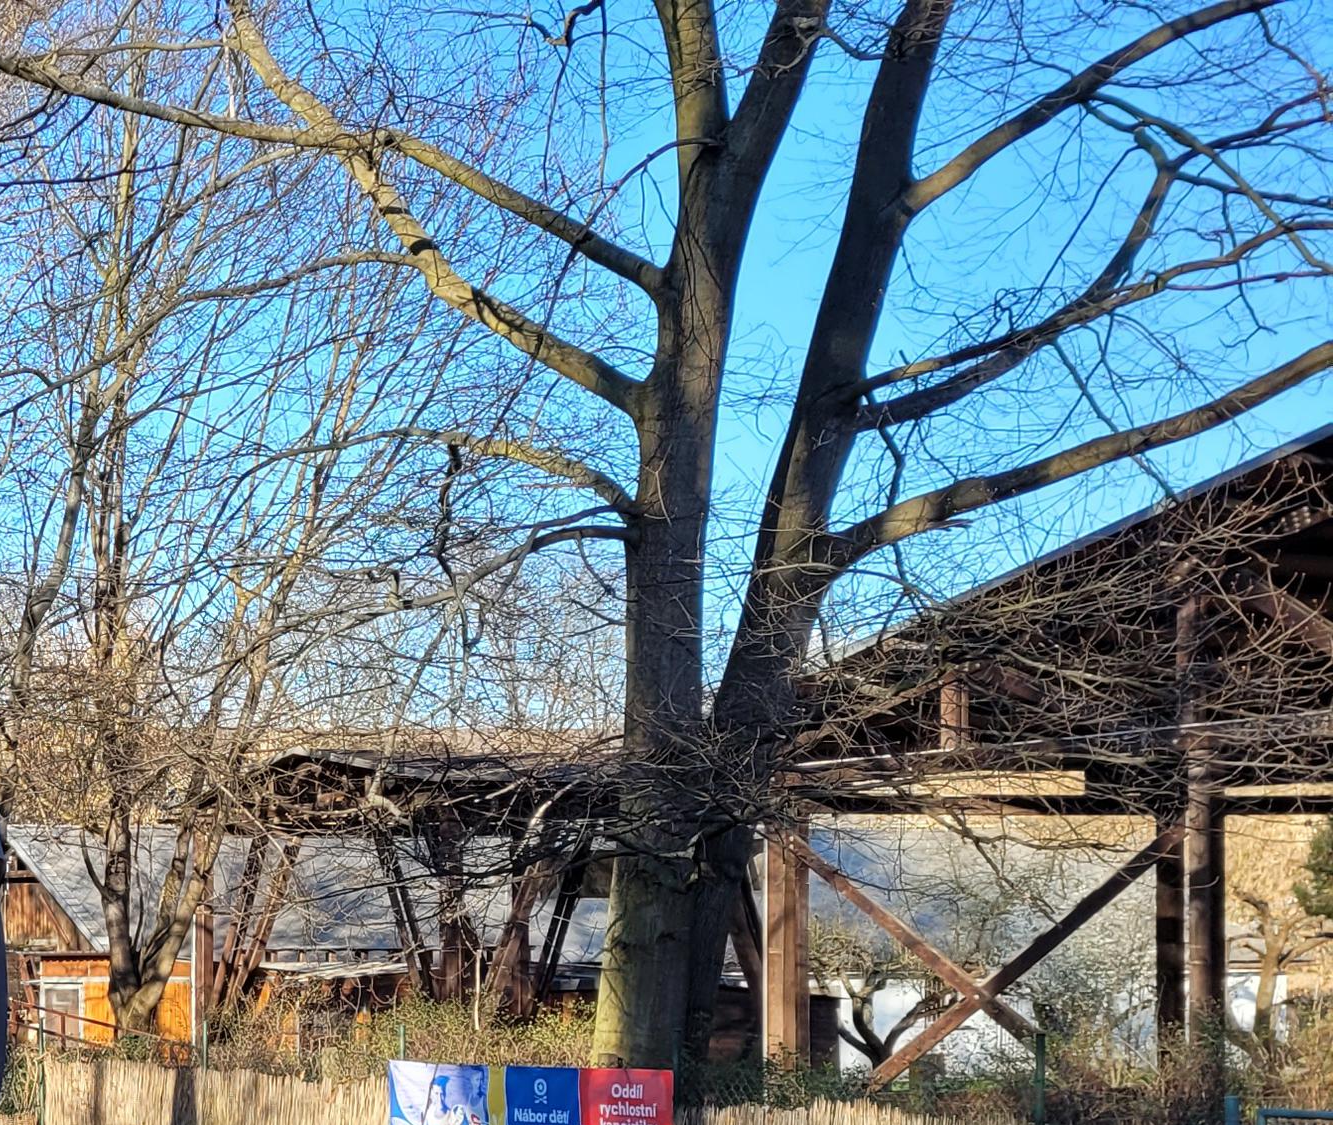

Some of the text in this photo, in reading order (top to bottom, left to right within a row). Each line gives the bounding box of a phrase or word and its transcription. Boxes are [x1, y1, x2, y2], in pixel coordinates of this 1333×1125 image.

[611, 1083, 643, 1099] Oddíl
[513, 1108, 547, 1123] Nábor
[599, 1102, 658, 1118] rychlostní
